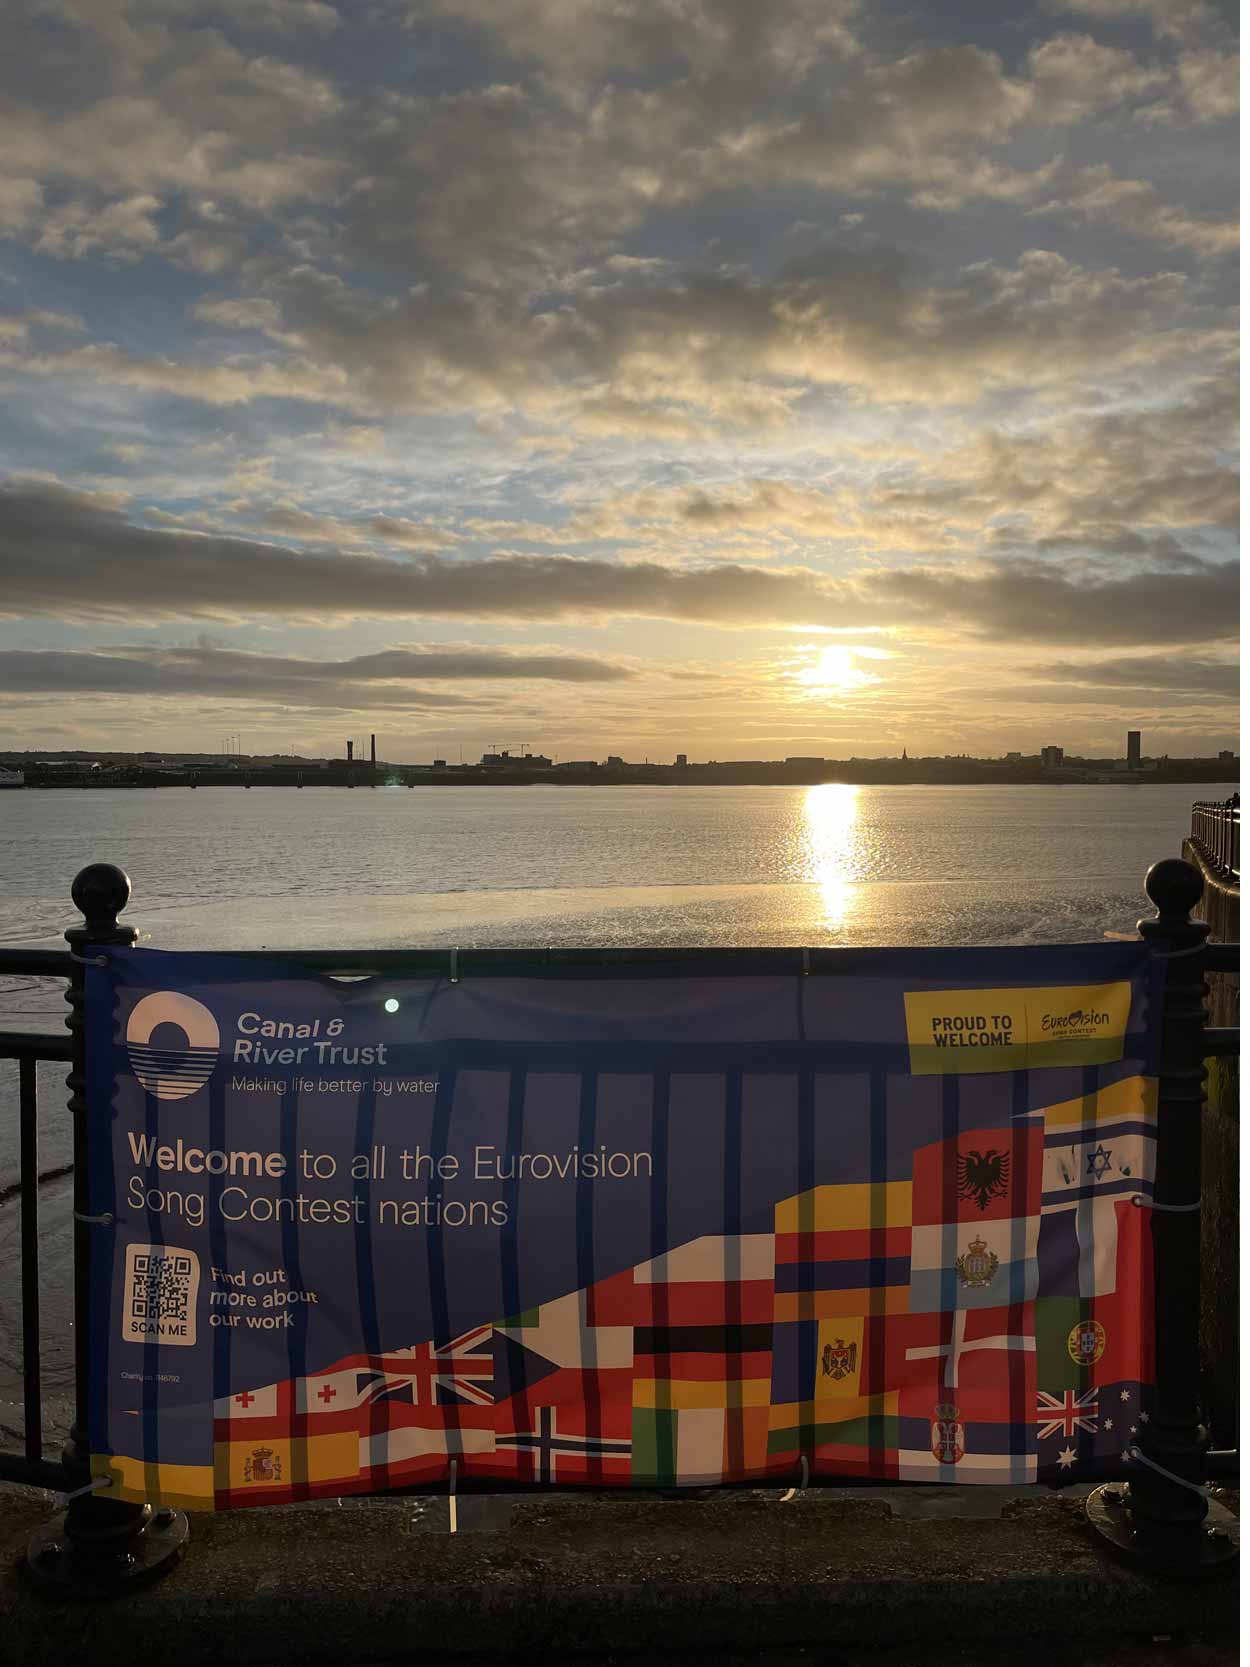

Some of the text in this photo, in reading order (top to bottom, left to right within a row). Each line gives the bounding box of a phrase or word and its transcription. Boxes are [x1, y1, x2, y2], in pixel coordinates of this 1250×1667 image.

[237, 1012, 345, 1039] Canal &
[932, 1015, 1013, 1031] PROUD TO
[933, 1032, 1013, 1047] WELCOME
[233, 1039, 388, 1065] River Trust
[232, 1076, 440, 1096] Making life better by water
[127, 1131, 652, 1180] Welcome to all the Eurovision
[127, 1176, 509, 1227] Song Contest nations
[210, 1267, 286, 1287] Find out
[209, 1289, 319, 1308] more about
[131, 1322, 187, 1336] SCAN ME
[209, 1310, 295, 1329] our work
